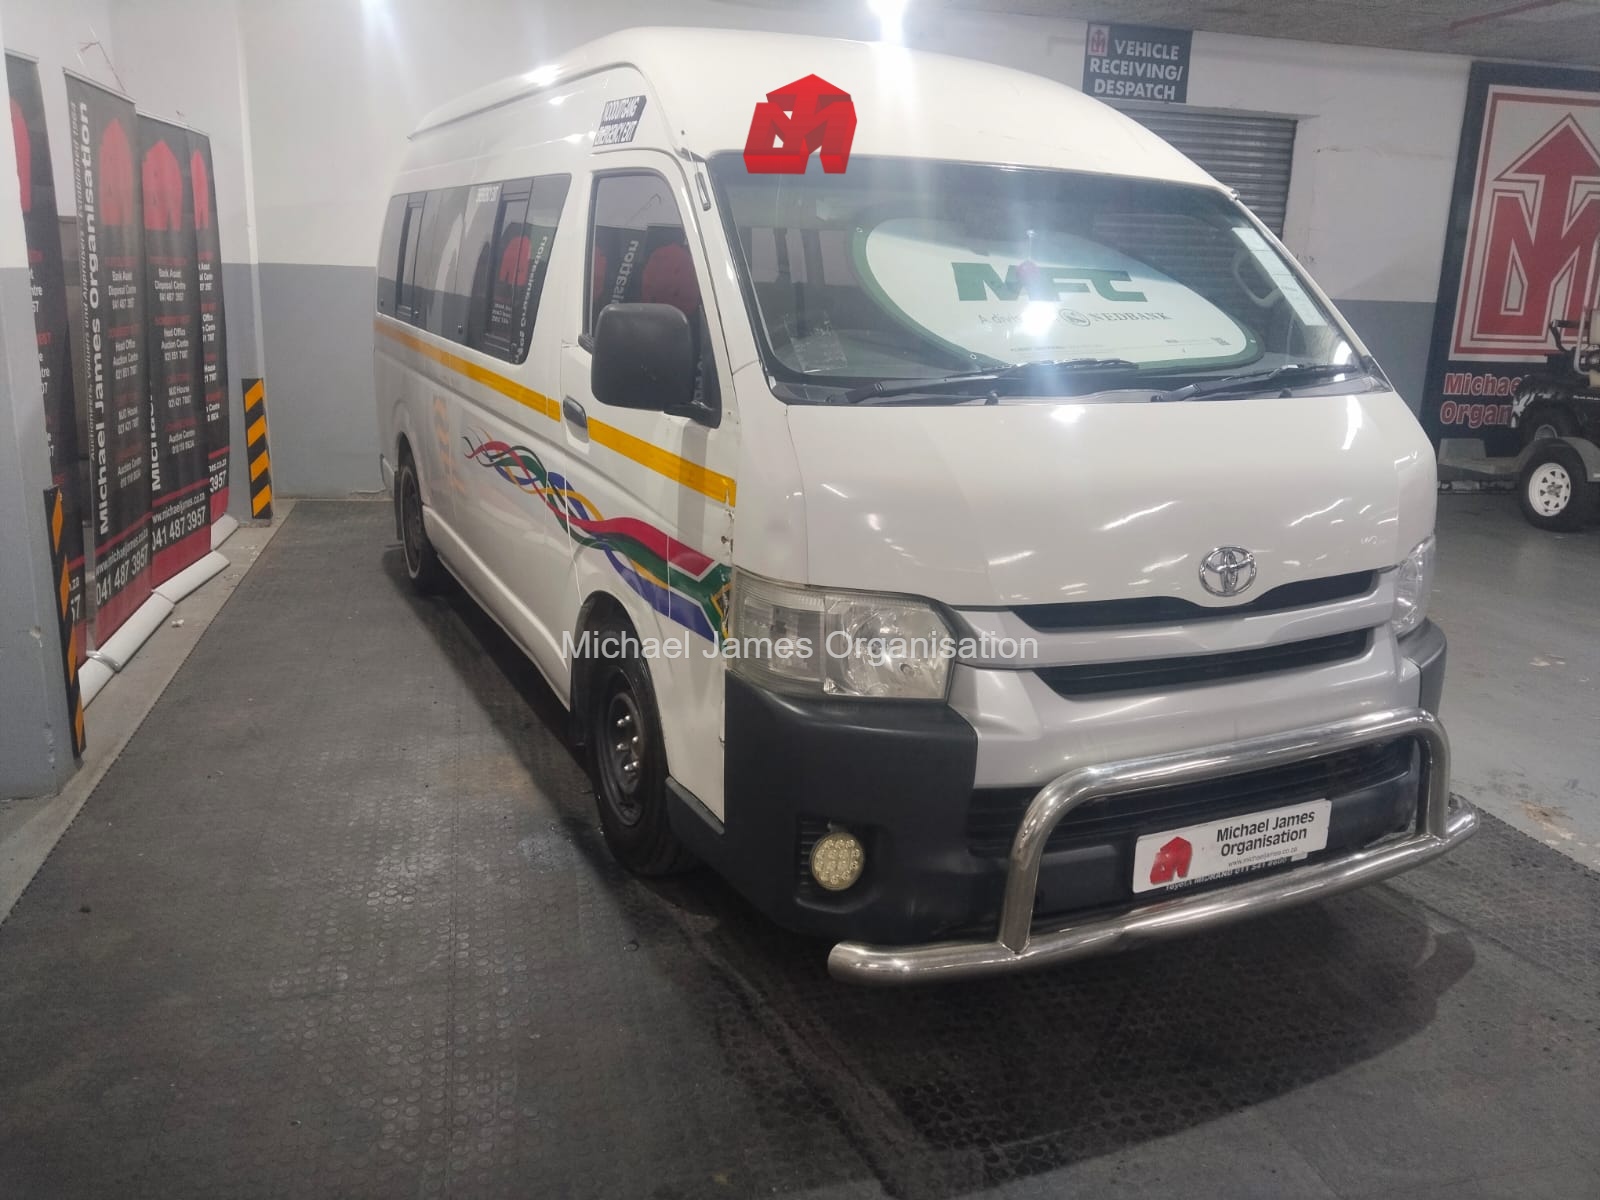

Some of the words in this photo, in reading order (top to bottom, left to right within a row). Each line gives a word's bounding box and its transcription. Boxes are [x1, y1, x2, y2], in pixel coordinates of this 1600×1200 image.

[1114, 40, 1180, 60] VEHICLE
[1089, 57, 1183, 81] RECEIVING/
[1094, 78, 1176, 100] DESPATCH
[80, 102, 99, 309] Organisation
[951, 262, 1148, 302] MFC
[1087, 312, 1172, 322] NEDBANK
[92, 318, 105, 414] James
[1443, 372, 1522, 396] Michae
[1440, 400, 1512, 429] Organ
[96, 423, 109, 535] Michael
[209, 470, 227, 494] 3957
[169, 516, 186, 540] 487
[186, 505, 207, 531] 3957
[95, 573, 112, 606] 041
[114, 560, 130, 590] 487
[131, 543, 149, 576] 3957
[1216, 818, 1269, 842] Michael
[1272, 811, 1315, 831] James
[1221, 827, 1307, 857] Organisation
